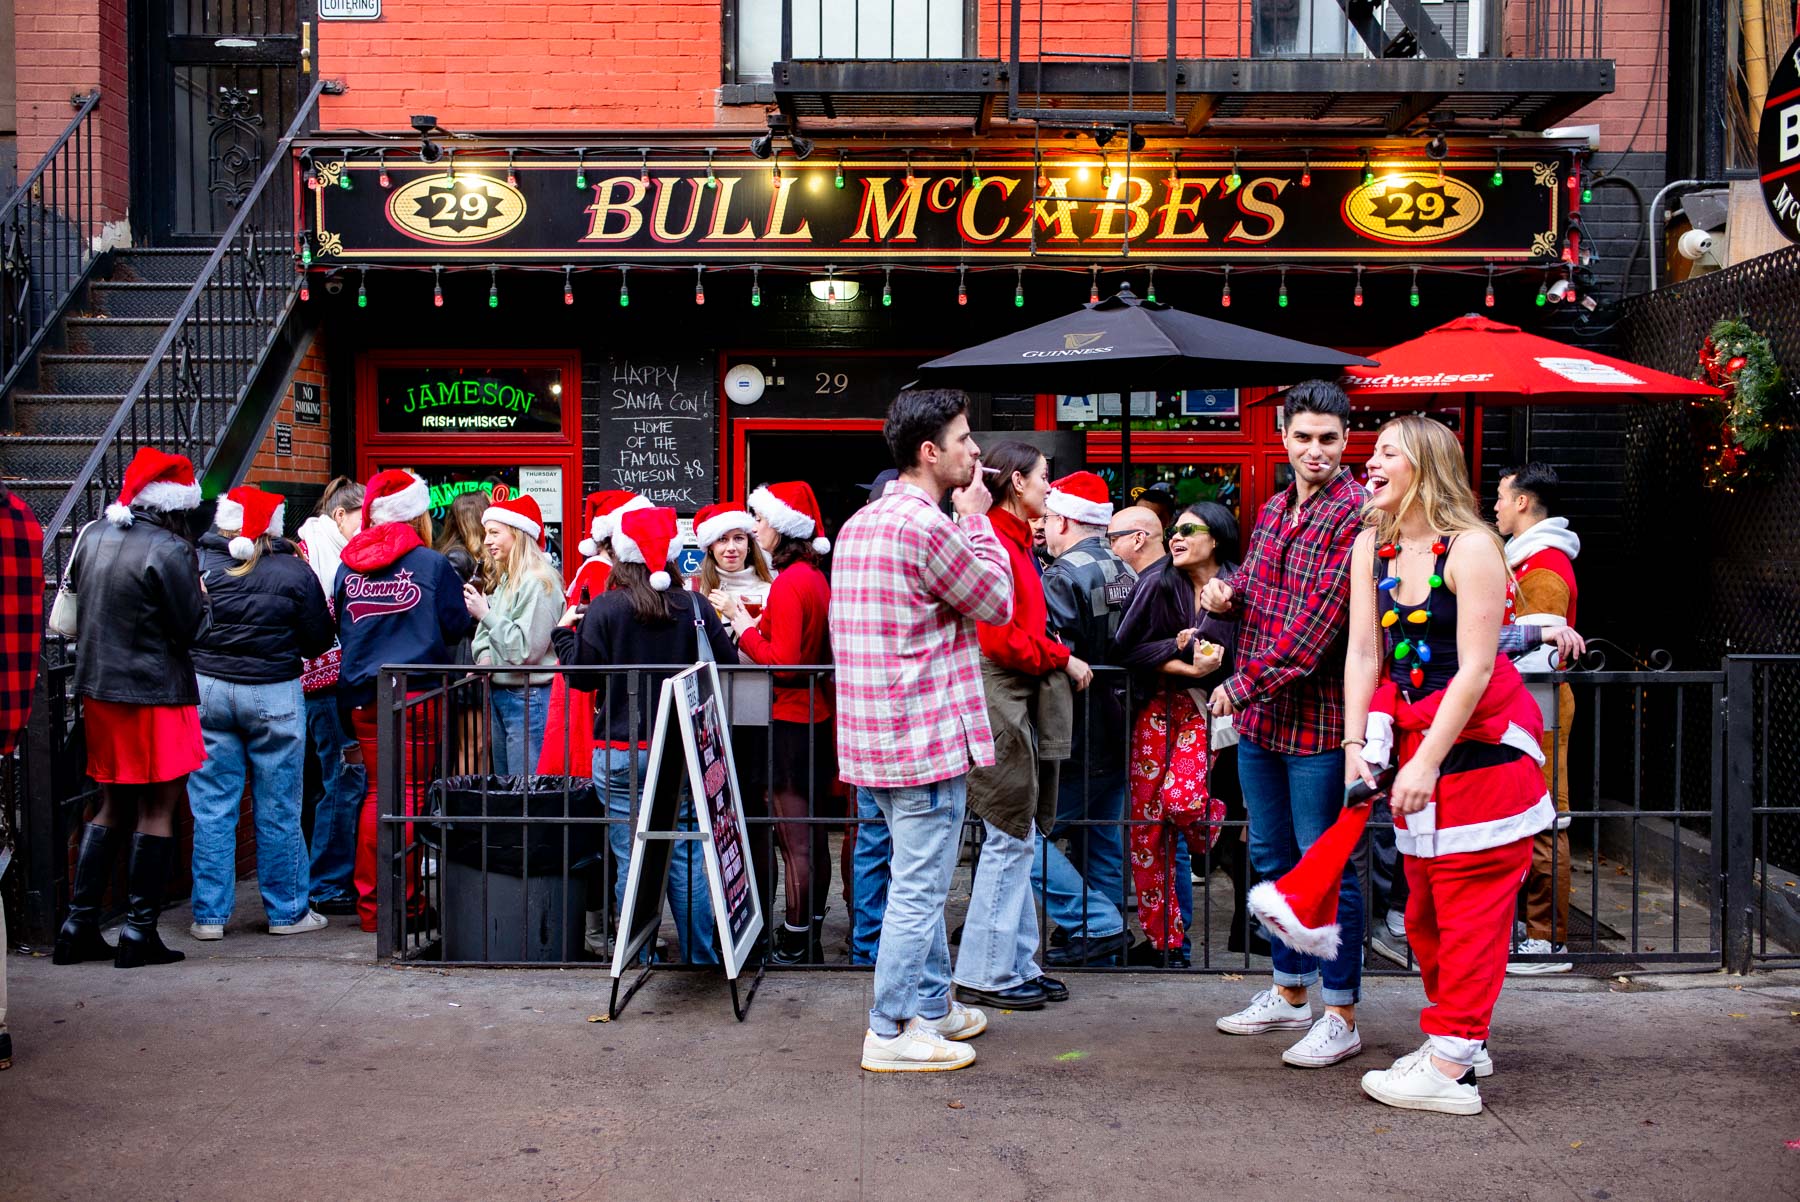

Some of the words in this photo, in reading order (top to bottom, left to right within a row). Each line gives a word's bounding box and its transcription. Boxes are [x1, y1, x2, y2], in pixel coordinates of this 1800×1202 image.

[325, 0, 375, 9] LOITERING
[431, 193, 488, 220] 29
[577, 176, 813, 243] BULL
[840, 176, 1291, 243] McCABE'S
[1387, 192, 1445, 220] 29
[1022, 346, 1114, 358] GUINNESS
[611, 360, 679, 391] HAPPY
[816, 372, 848, 394] 29
[1338, 373, 1494, 384] Budweiser
[302, 387, 313, 400] NO
[404, 381, 535, 413] JAMESON
[611, 389, 664, 410] SANTA
[296, 401, 320, 416] SMOKING
[422, 415, 456, 427] IRISH
[458, 415, 517, 427] WHISKEY
[633, 421, 673, 434] HOME
[626, 436, 647, 449] OF
[653, 436, 678, 450] THE
[620, 450, 681, 467] FAMOUS
[611, 467, 676, 486] JAMESON
[684, 459, 705, 479] $8
[345, 573, 412, 602] Tommy
